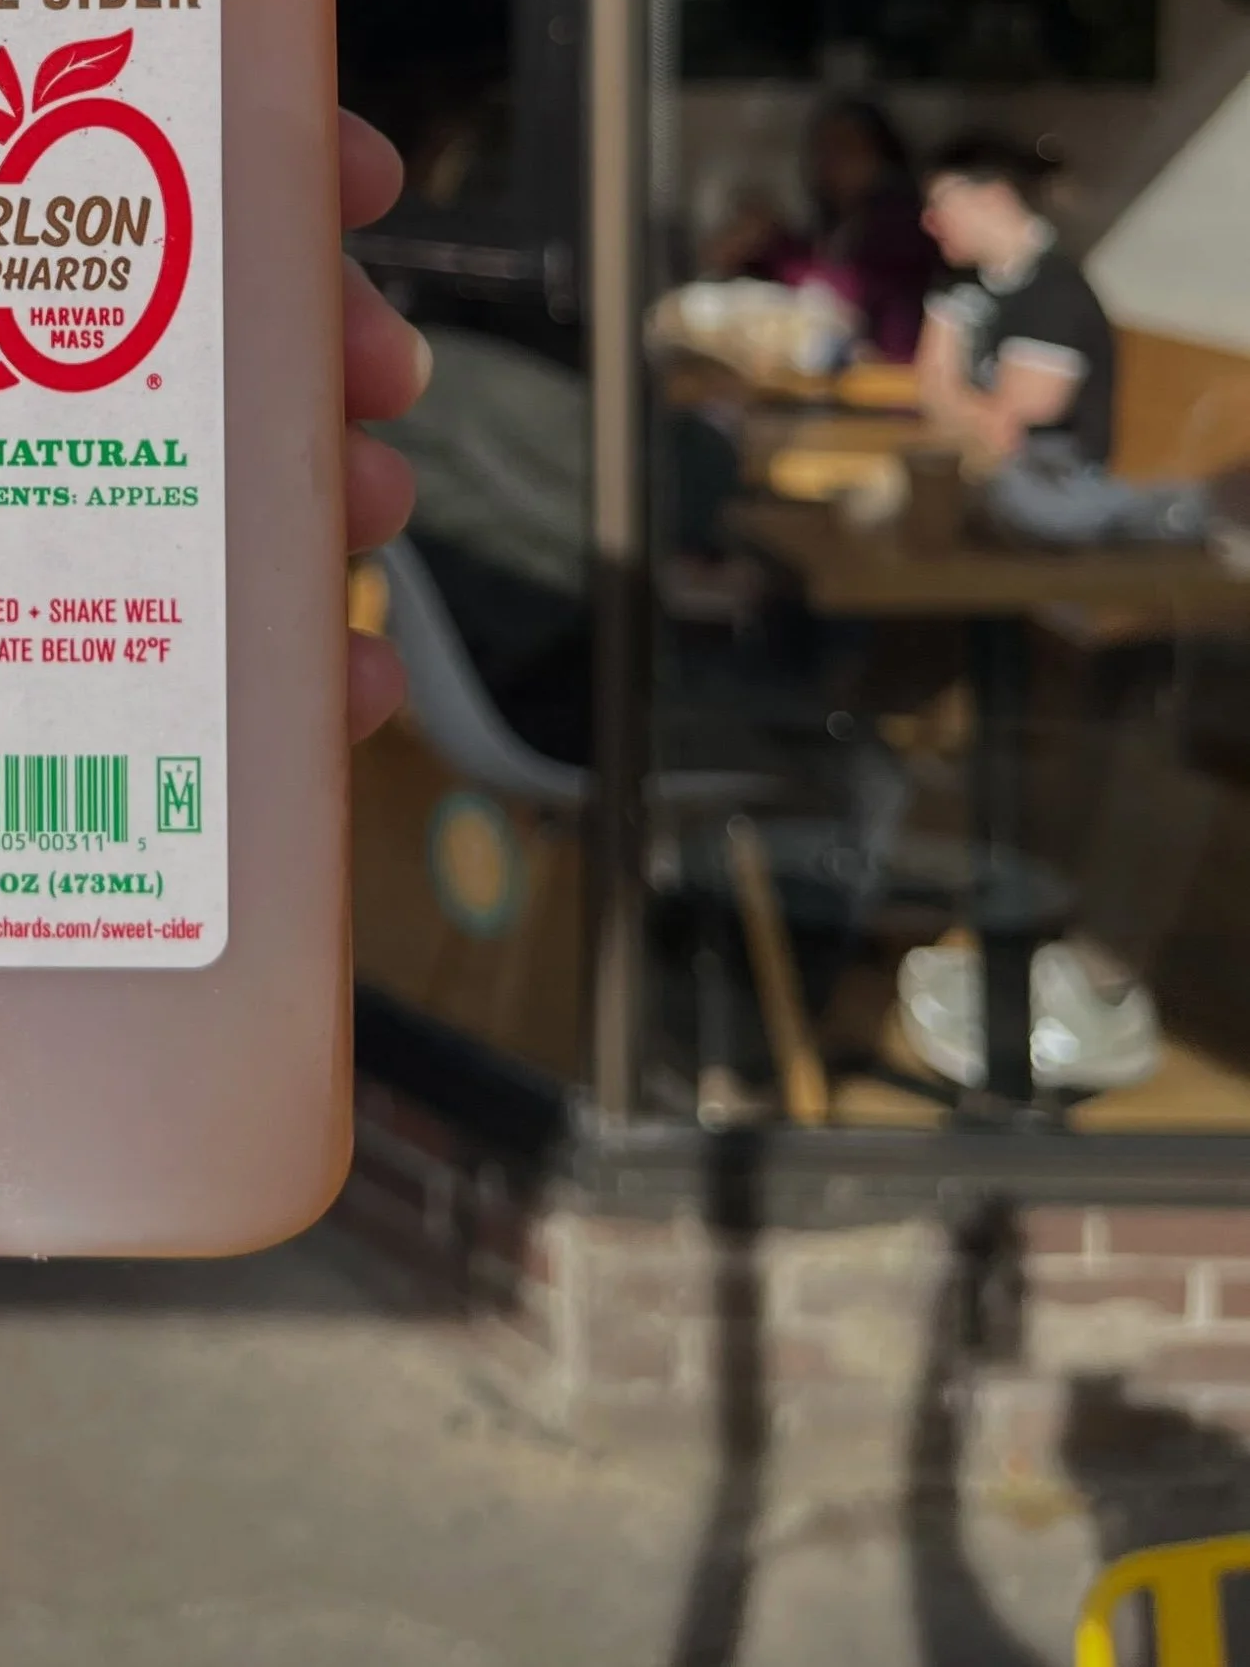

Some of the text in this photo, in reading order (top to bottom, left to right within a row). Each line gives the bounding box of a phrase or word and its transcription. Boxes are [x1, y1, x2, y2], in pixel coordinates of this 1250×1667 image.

[30, 306, 125, 327] HARVARD
[50, 329, 105, 350] MASS
[85, 486, 199, 507] APPLES
[49, 598, 117, 624] SHAKE
[124, 598, 183, 624] WELL
[41, 637, 116, 663] BELOW
[37, 832, 104, 852] 00311
[137, 836, 147, 852] 5
[48, 871, 164, 898] (473ML)
